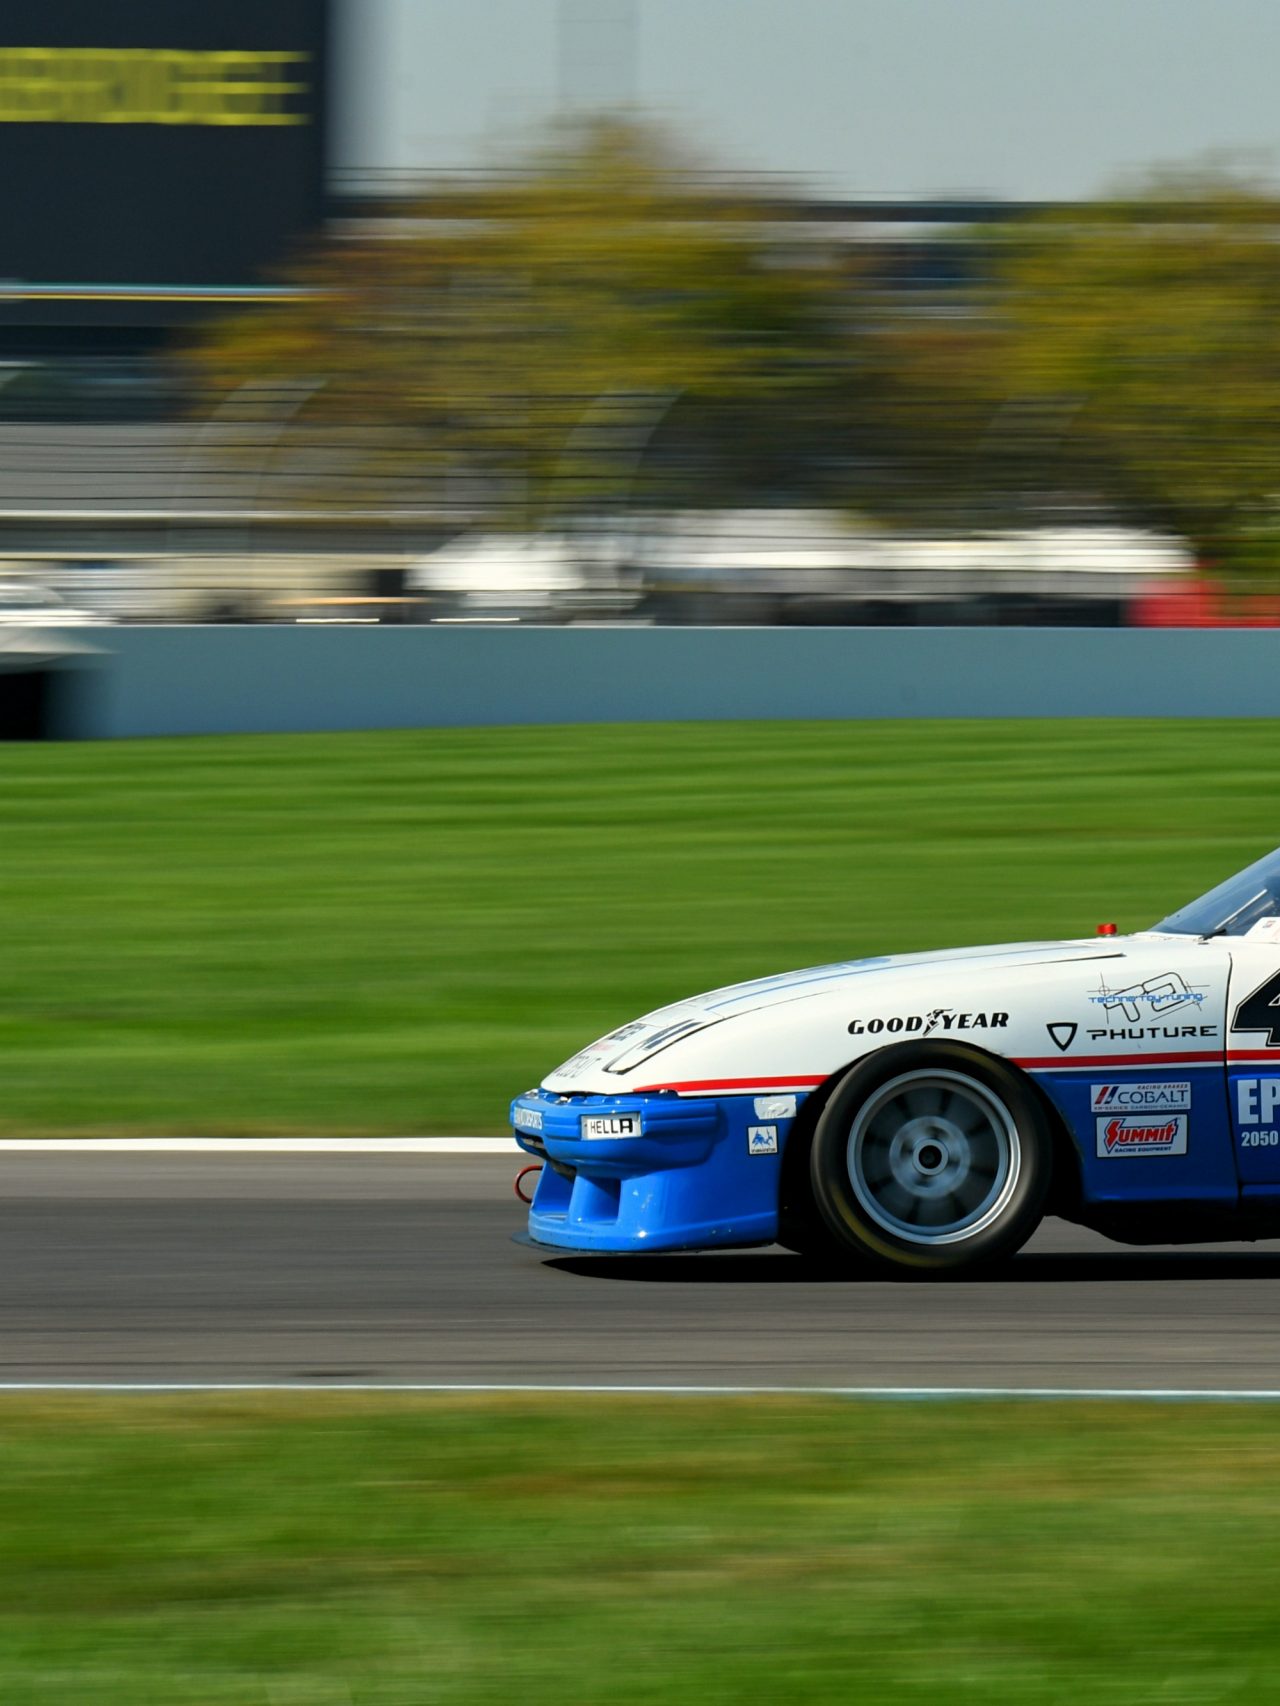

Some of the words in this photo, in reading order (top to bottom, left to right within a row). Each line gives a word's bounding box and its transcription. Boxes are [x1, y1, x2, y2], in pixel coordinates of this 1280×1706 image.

[1086, 1025, 1218, 1041] PHUTURE
[1117, 1089, 1189, 1105] COBALT
[590, 1117, 633, 1134] HELLA
[1241, 1130, 1280, 1147] 2050
